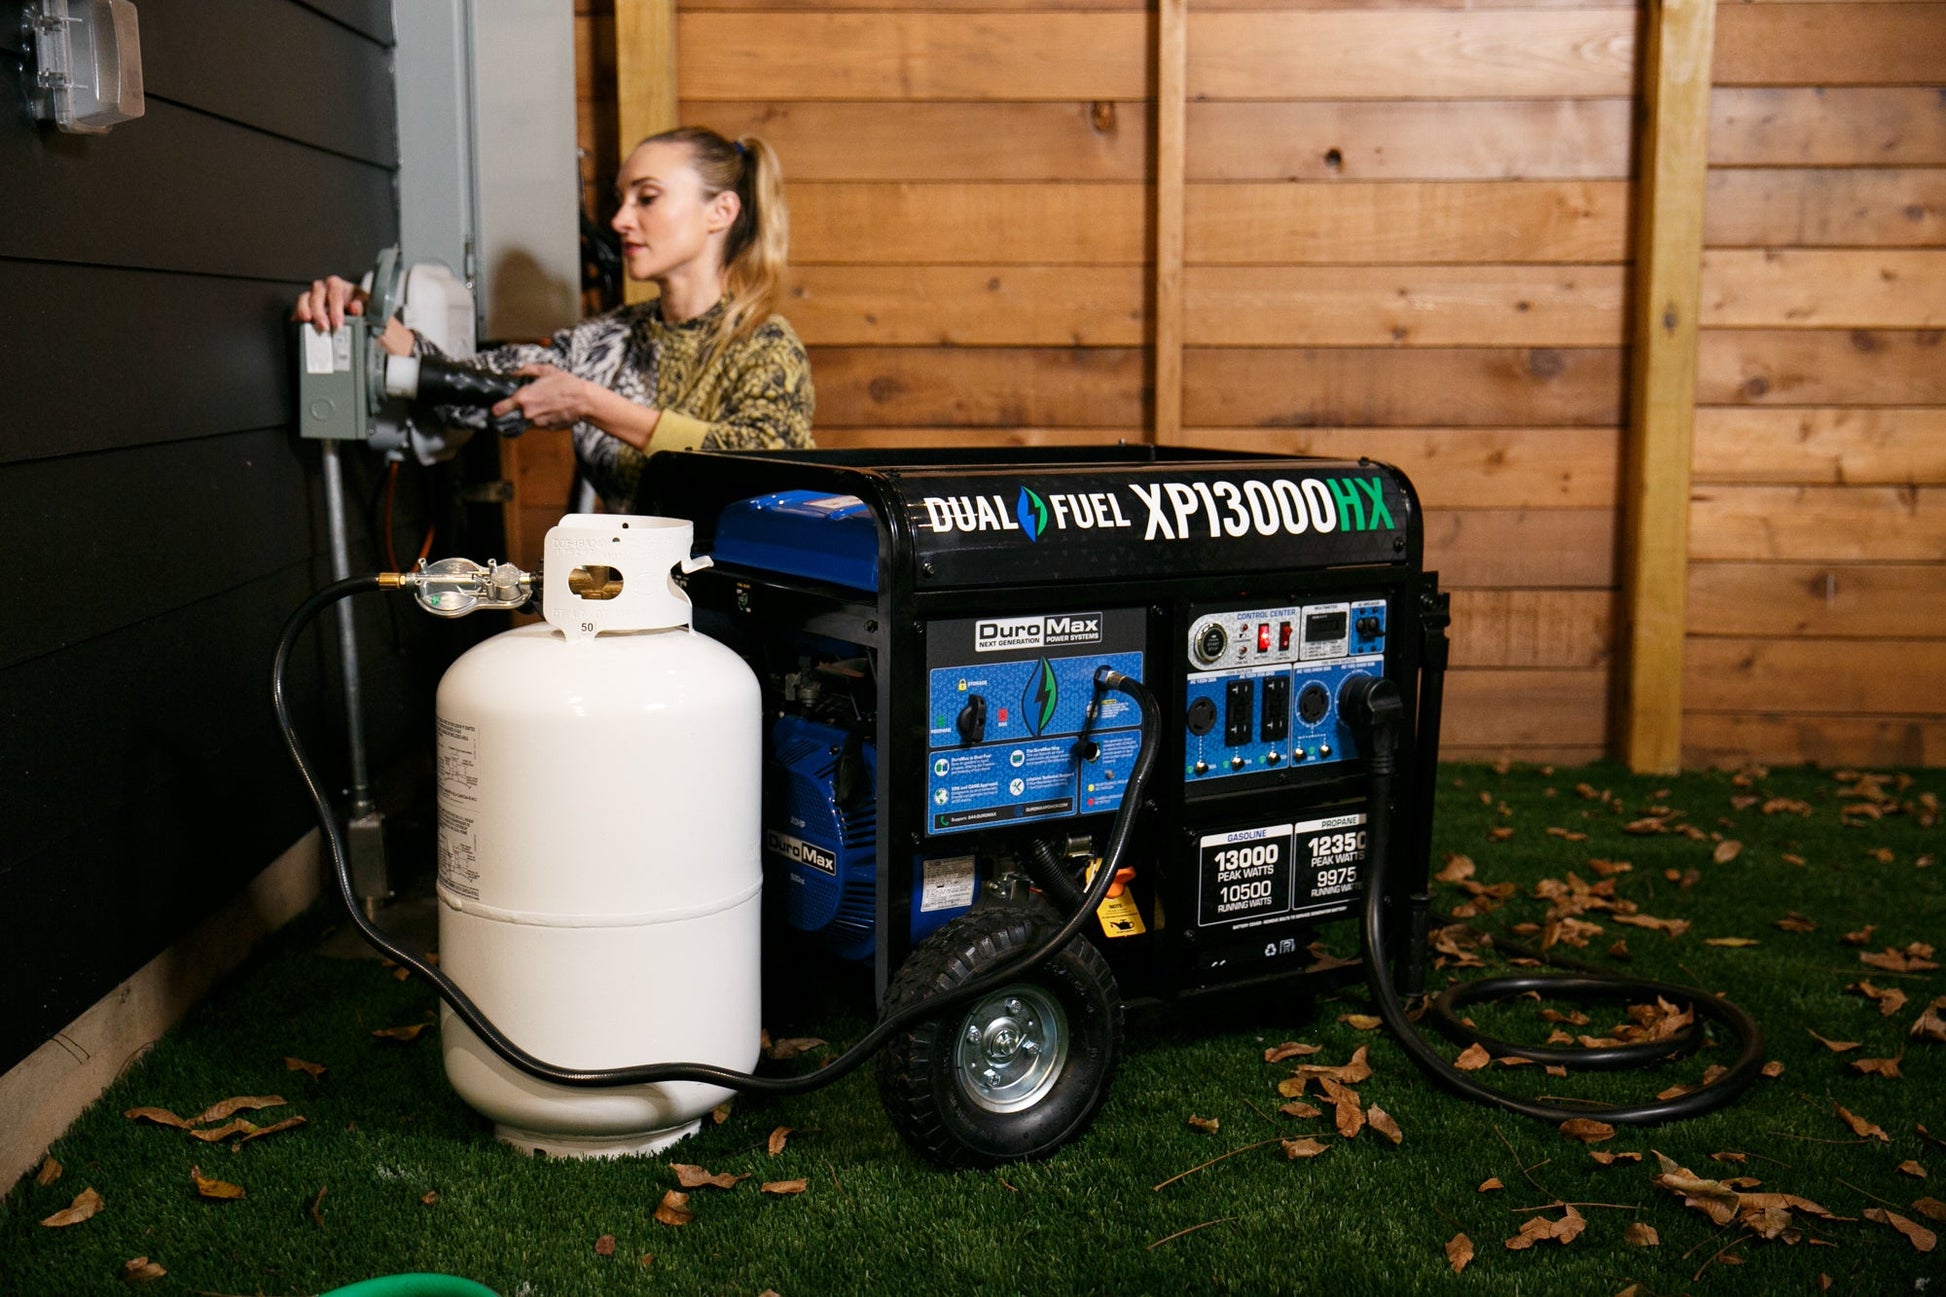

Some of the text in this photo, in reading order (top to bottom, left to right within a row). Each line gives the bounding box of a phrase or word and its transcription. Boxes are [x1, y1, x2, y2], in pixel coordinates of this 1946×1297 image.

[924, 477, 1395, 540] DUAL FUEL XP13000HX
[1237, 609, 1296, 620] CONTROL CENTER
[581, 623, 594, 632] 50
[998, 638, 1040, 646] GENERATION
[1046, 632, 1099, 643] POWER SYSTEMS
[1322, 816, 1357, 828] PROPANE
[1228, 830, 1266, 842] GASOLINE
[1214, 844, 1278, 872] 13000
[1311, 856, 1334, 868] PEAK
[1218, 865, 1274, 882] PEAK WATTS
[1317, 867, 1356, 888] 9975
[1220, 880, 1271, 903] 10500
[1311, 886, 1340, 897] RUNNING
[1218, 896, 1272, 913] RUNNING WATTS
